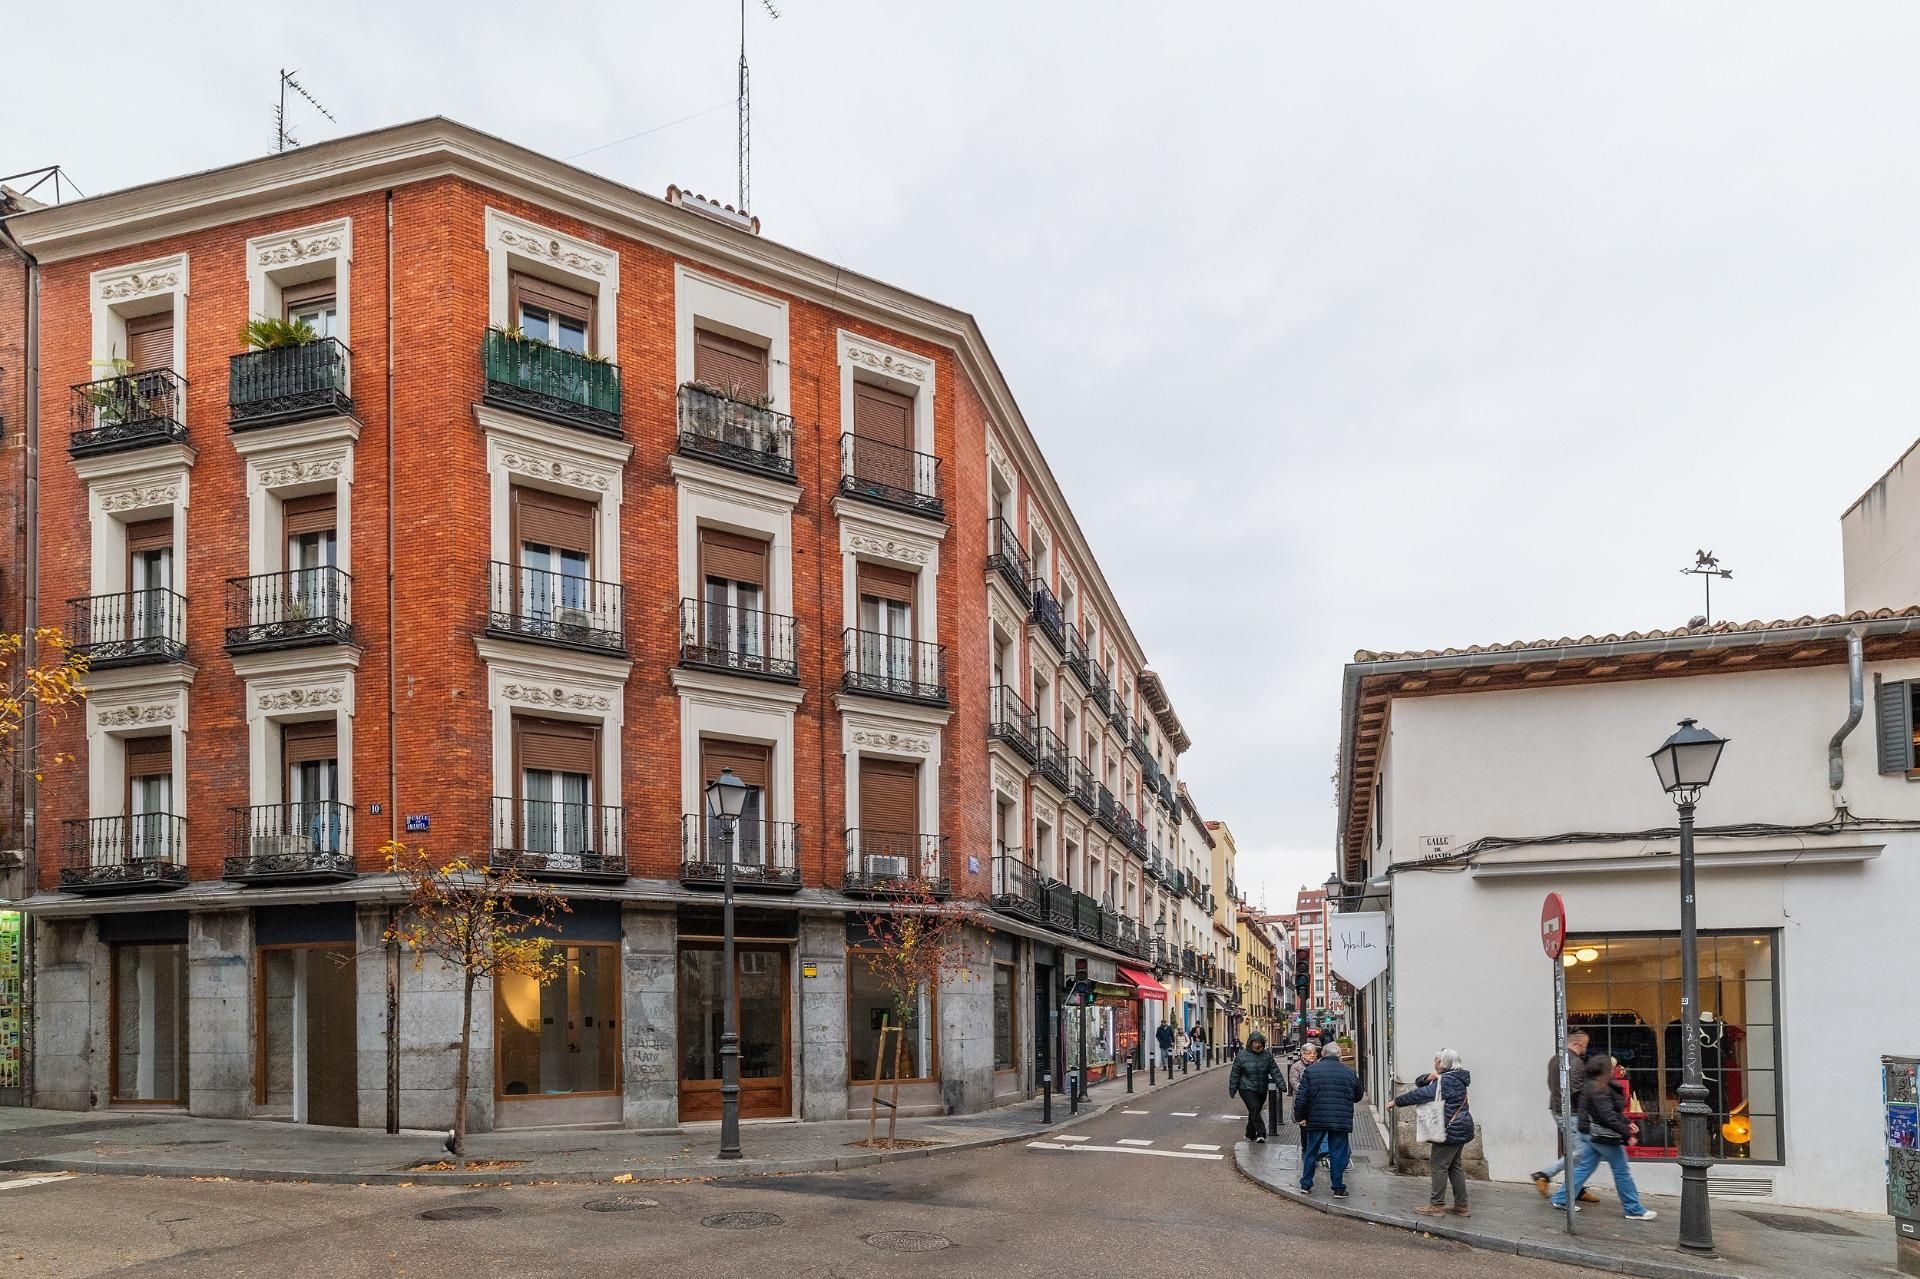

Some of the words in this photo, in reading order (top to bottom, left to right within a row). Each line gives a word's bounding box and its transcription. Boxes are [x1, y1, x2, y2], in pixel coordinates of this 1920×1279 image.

[371, 804, 380, 813] 10
[1427, 837, 1449, 845] CALLE
[1340, 930, 1377, 961] Sybilla
